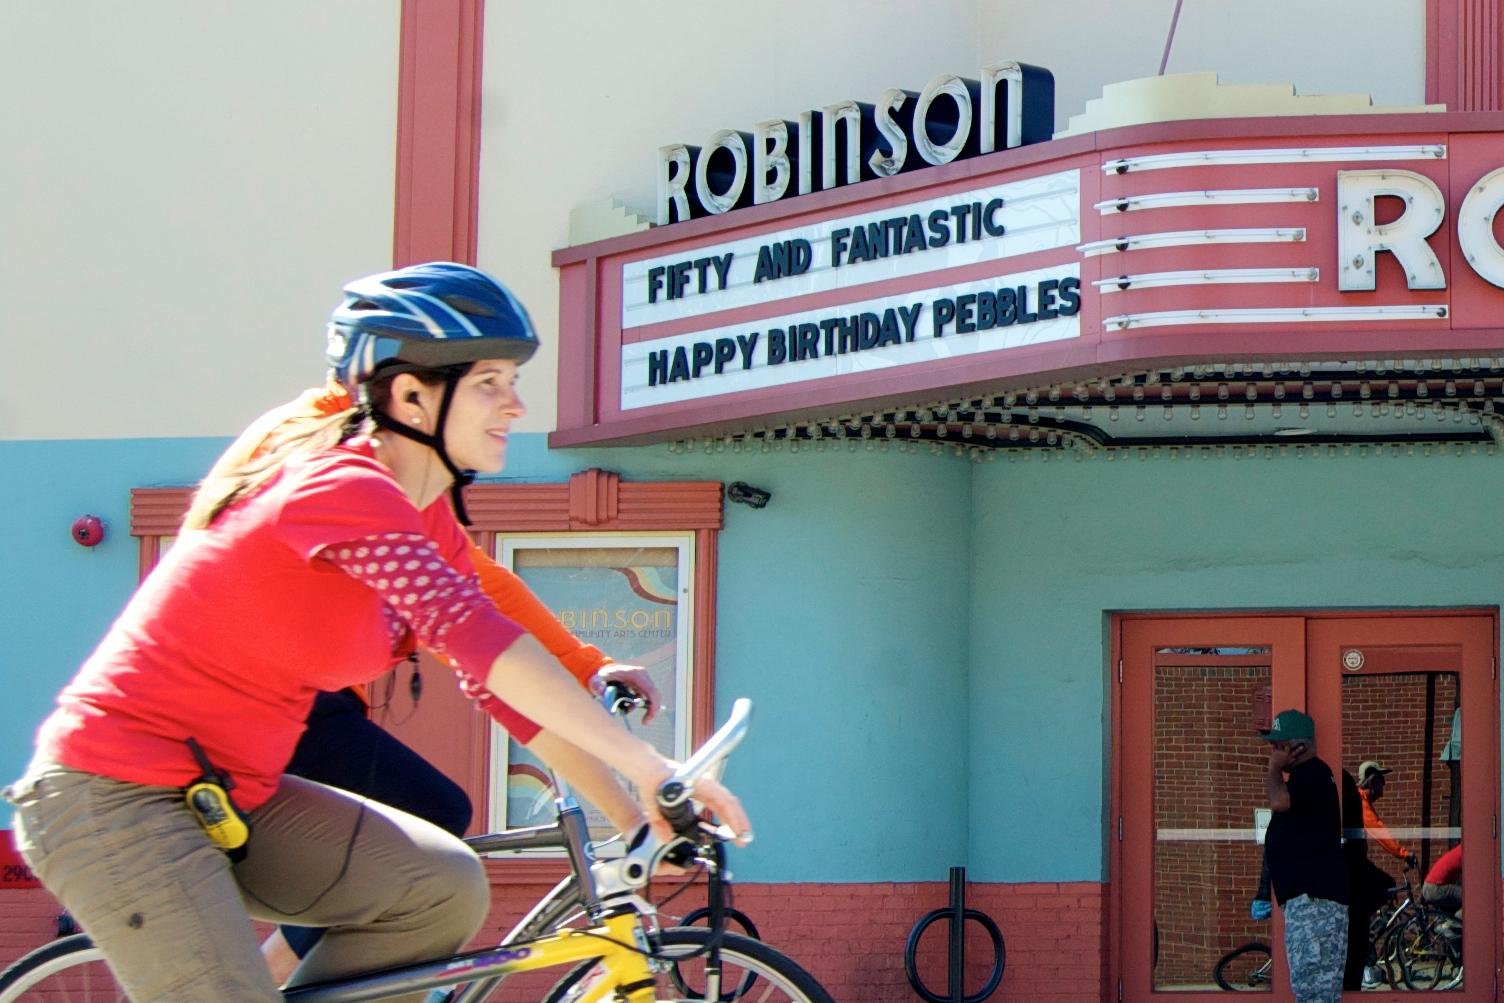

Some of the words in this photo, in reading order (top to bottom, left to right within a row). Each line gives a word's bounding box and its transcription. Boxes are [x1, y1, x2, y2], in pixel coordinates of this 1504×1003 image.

[647, 252, 734, 304] FIFTY
[753, 238, 812, 284] AND
[831, 199, 1006, 268] FANTASTIC
[648, 332, 759, 387] HAPPY
[767, 302, 923, 366] BIRTHDAY
[932, 277, 1081, 338] PEBBLES
[560, 608, 672, 629] BINSON
